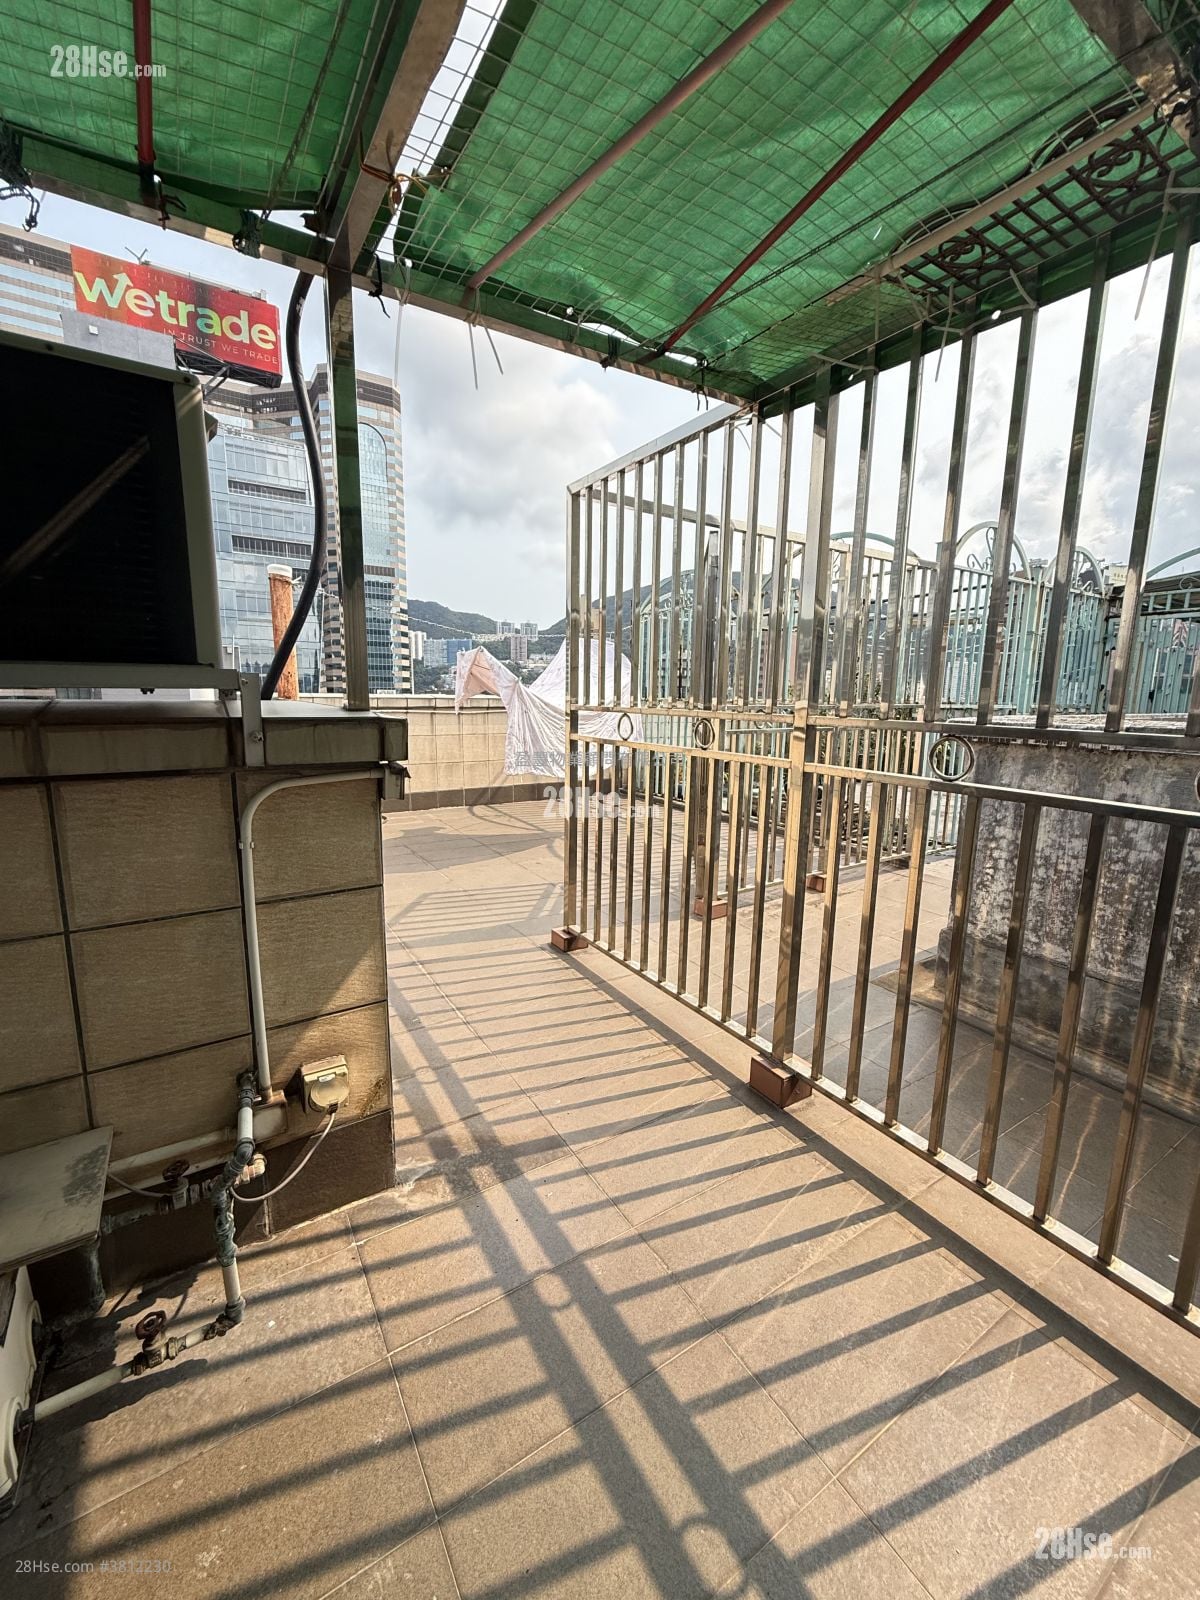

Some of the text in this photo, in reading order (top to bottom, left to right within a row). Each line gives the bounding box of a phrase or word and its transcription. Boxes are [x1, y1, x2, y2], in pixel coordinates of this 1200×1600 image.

[180, 332, 217, 348] TRUST
[221, 343, 240, 354] WE
[242, 348, 279, 365] TRADE
